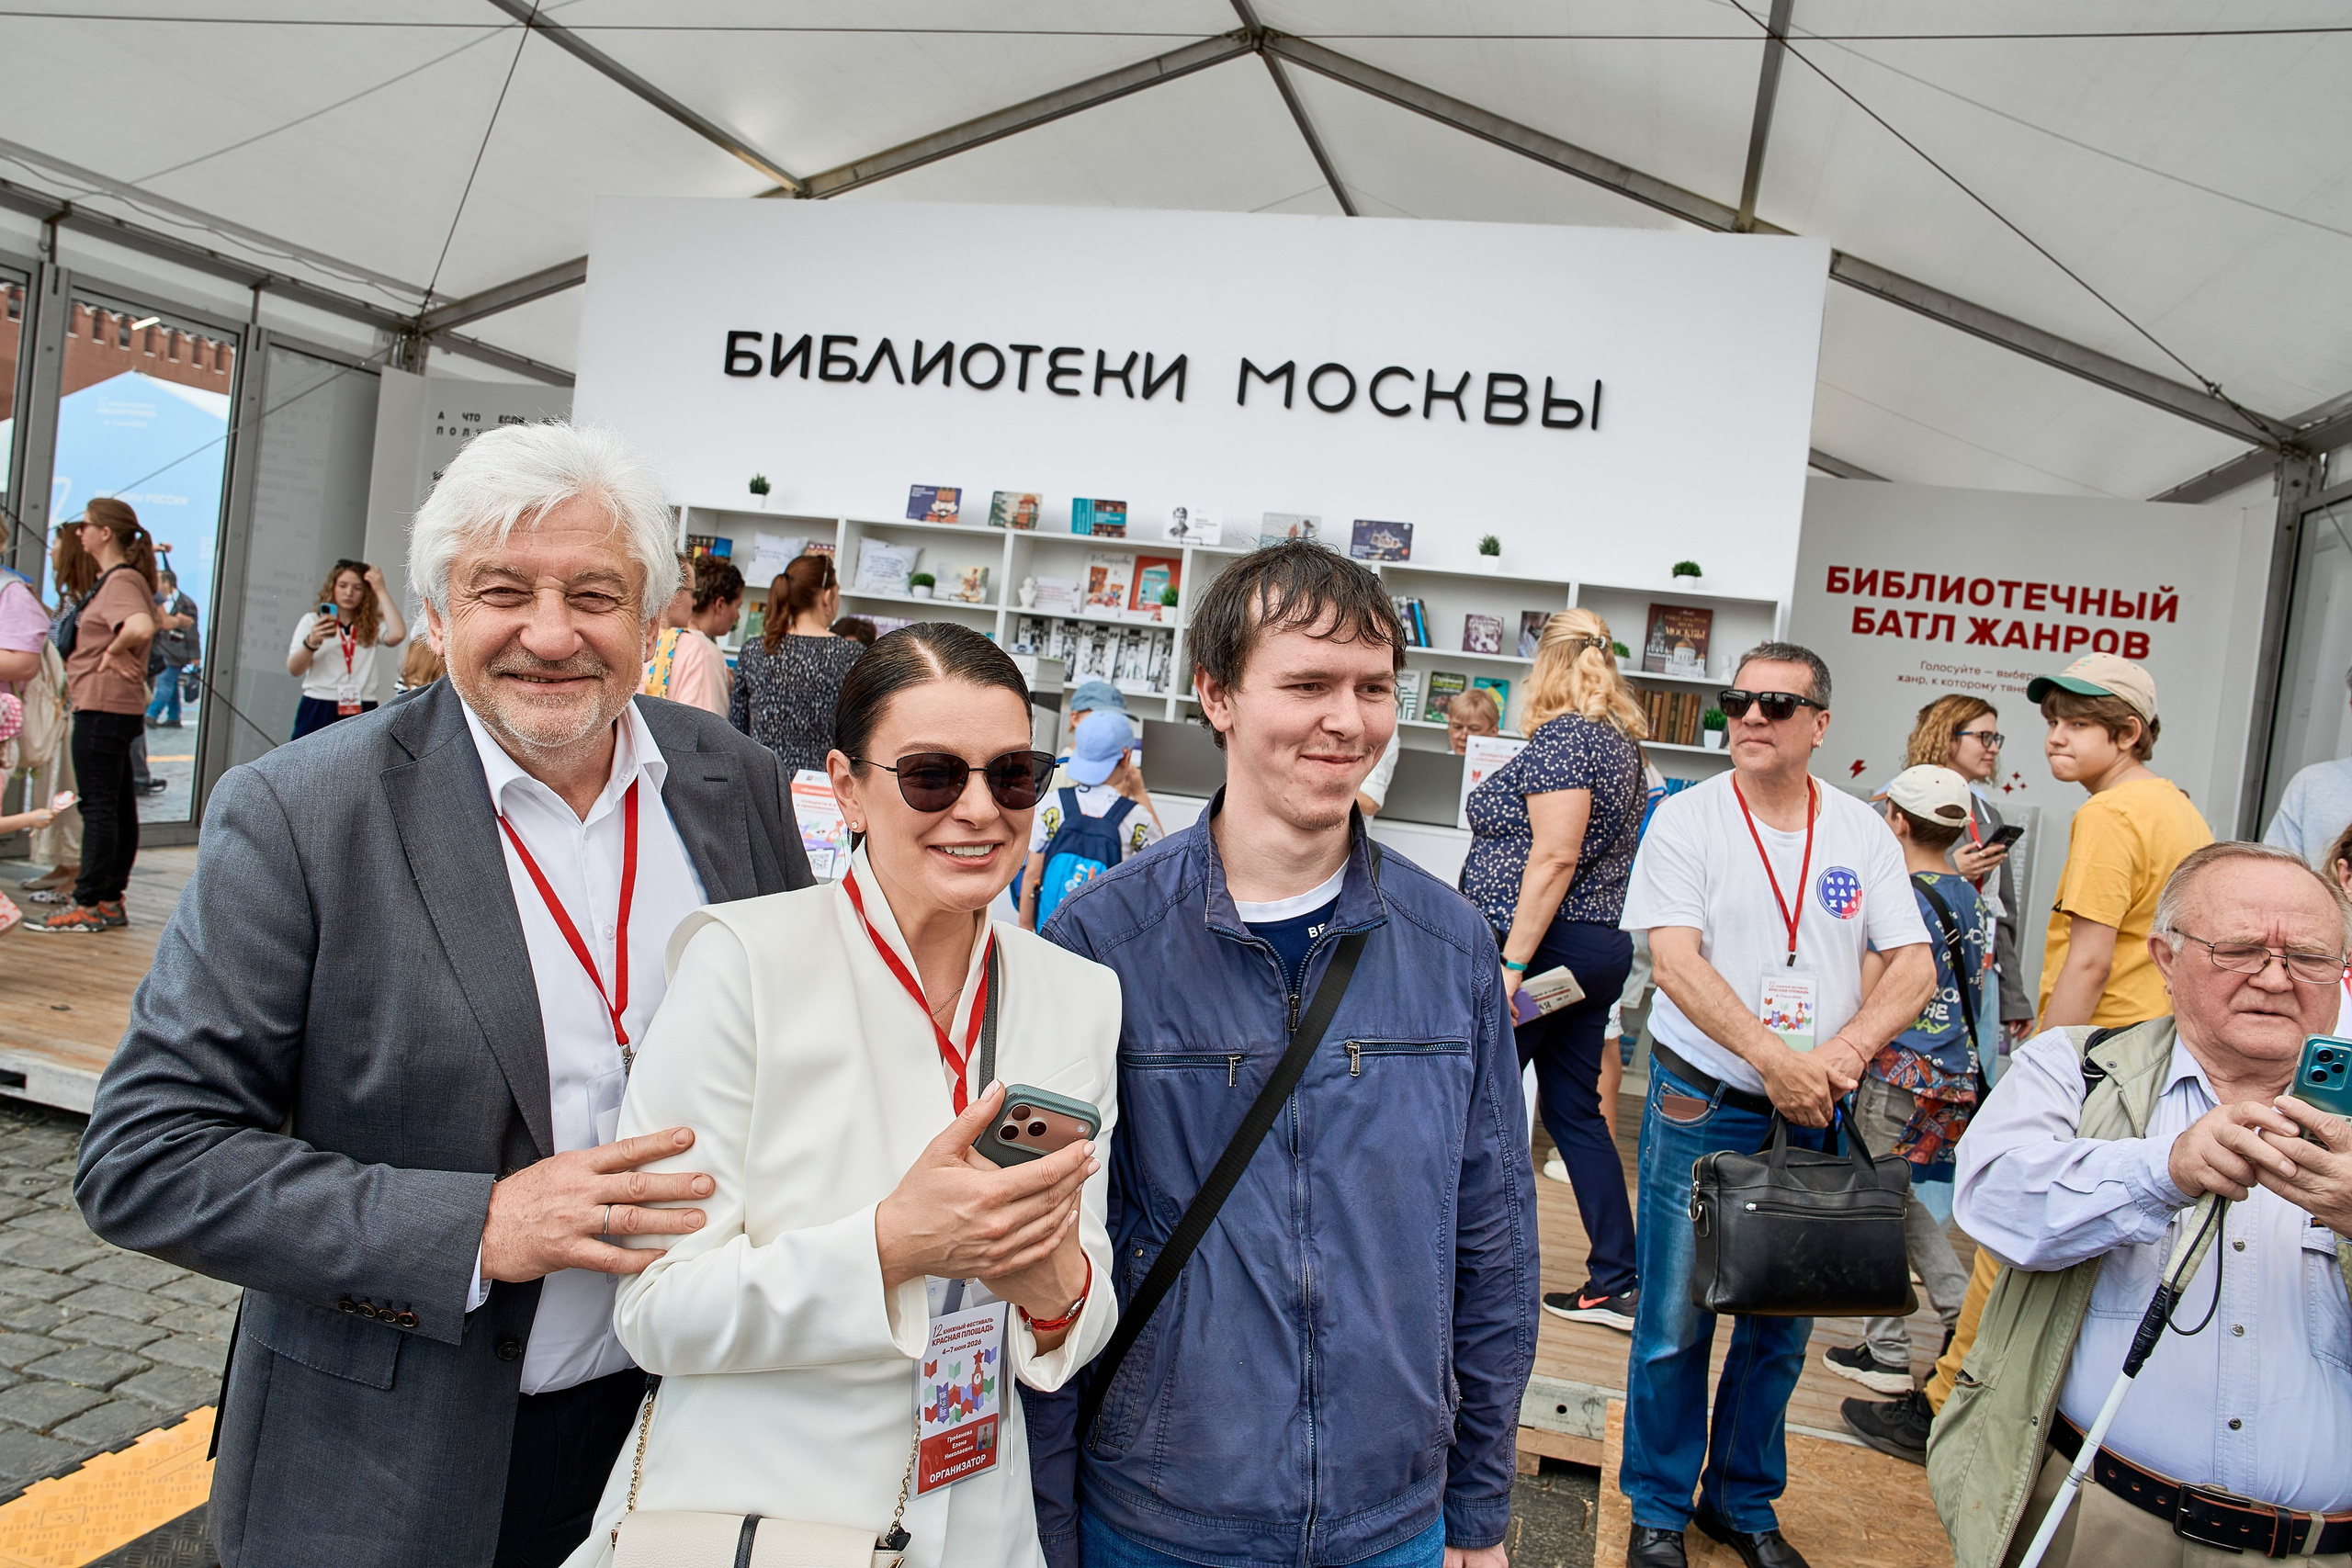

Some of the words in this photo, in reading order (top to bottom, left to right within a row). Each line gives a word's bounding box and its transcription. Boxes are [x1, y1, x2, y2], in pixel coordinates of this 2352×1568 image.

[724, 330, 1187, 402] БИБЛИОТЕКИ
[1237, 356, 1602, 431] МОСКВЫ
[437, 411, 445, 420] А
[462, 412, 481, 423] ЧТО
[1826, 565, 2179, 624] БИБЛИОТЕЧНЫЙ
[1851, 606, 1955, 643] БАТЛ
[1965, 616, 2151, 661] ЖАНРОВ
[1920, 660, 1981, 675] Голосуйте
[1996, 670, 2046, 681] выбер
[1897, 674, 1928, 685] жанр,
[1941, 679, 1997, 692] которому
[2001, 683, 2028, 694] тяне
[932, 1332, 961, 1347] КРАСНАЯ
[961, 1324, 994, 1338] ПЛОЩАДЬ
[943, 1323, 967, 1335] КНИЖНЫЙ
[967, 1338, 982, 1348] 2026
[944, 1445, 974, 1460] Николаевна
[952, 1439, 967, 1449] Елена
[930, 1454, 987, 1483] ОРГАНИЗАТОР
